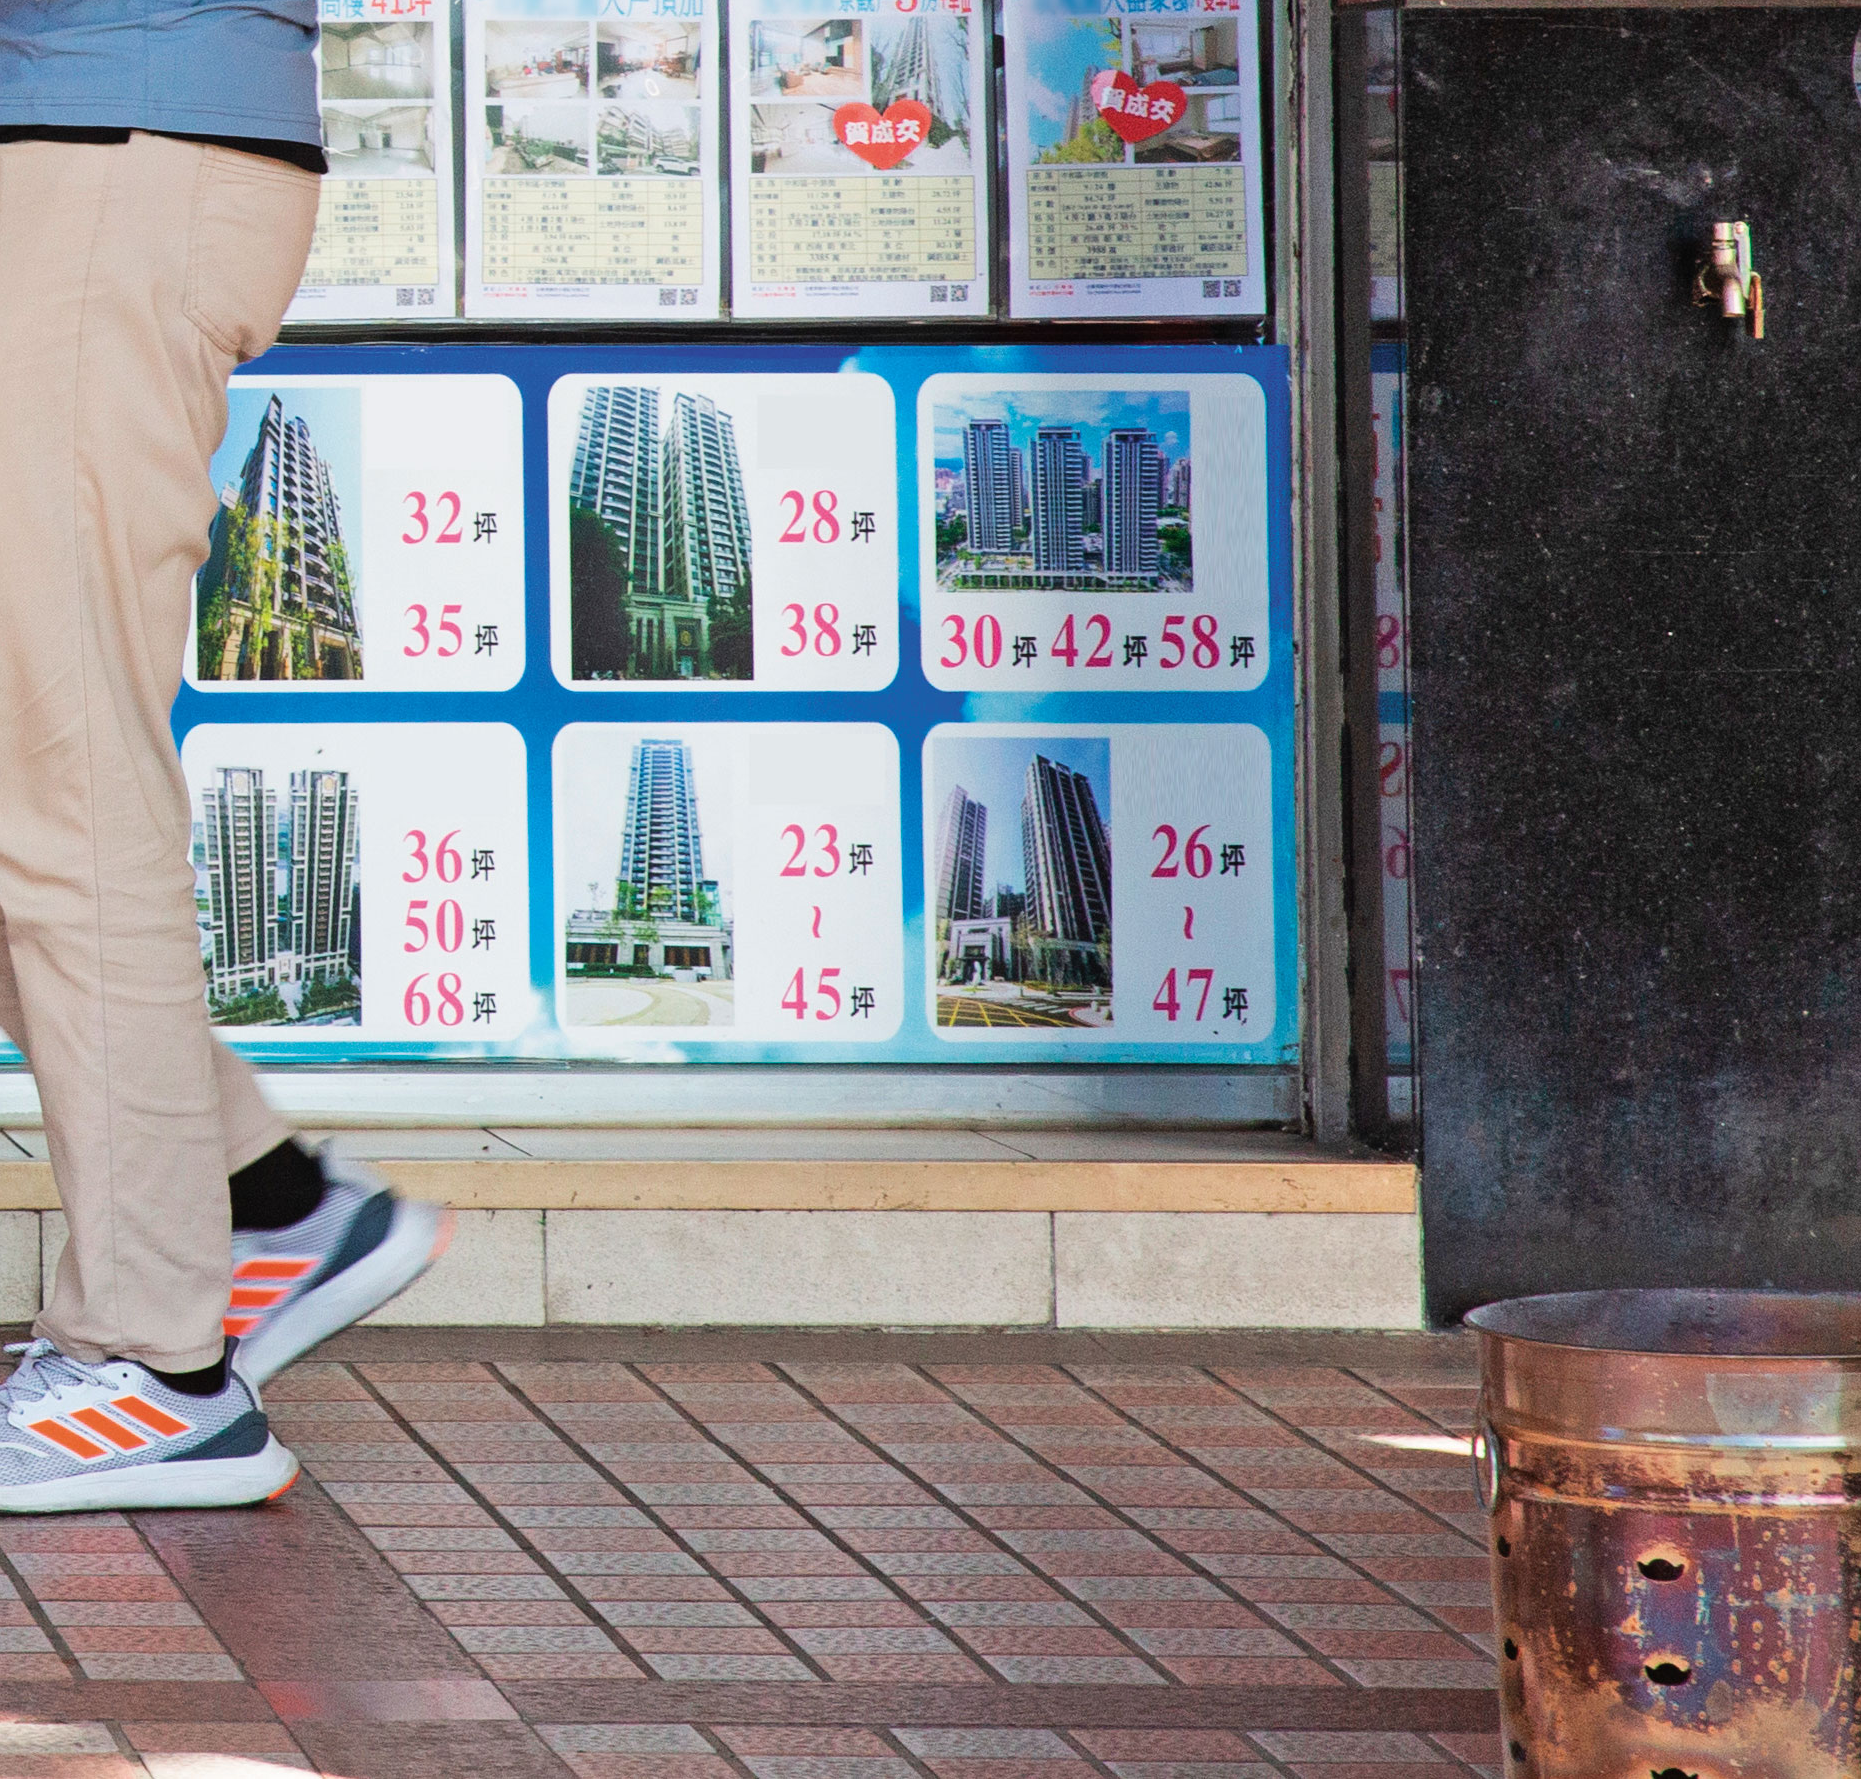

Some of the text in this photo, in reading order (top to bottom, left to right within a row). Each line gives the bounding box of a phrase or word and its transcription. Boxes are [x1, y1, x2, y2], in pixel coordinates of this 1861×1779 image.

[1102, 86, 1177, 124] 賀成交
[844, 119, 921, 146] 賀成交
[402, 491, 498, 544] 32坪
[778, 490, 876, 543] 28坪
[403, 604, 499, 657] 35坪
[780, 603, 877, 656] 38坪
[940, 614, 1255, 669] 30坪 42坪 58坪
[402, 829, 495, 883] 36坪
[779, 824, 874, 878] 23坪
[1151, 824, 1246, 878] 26坪
[403, 899, 496, 953] 50坪
[404, 972, 497, 1026] 68坪
[781, 967, 876, 1021] 45坪
[1152, 968, 1249, 1022] 47坪
